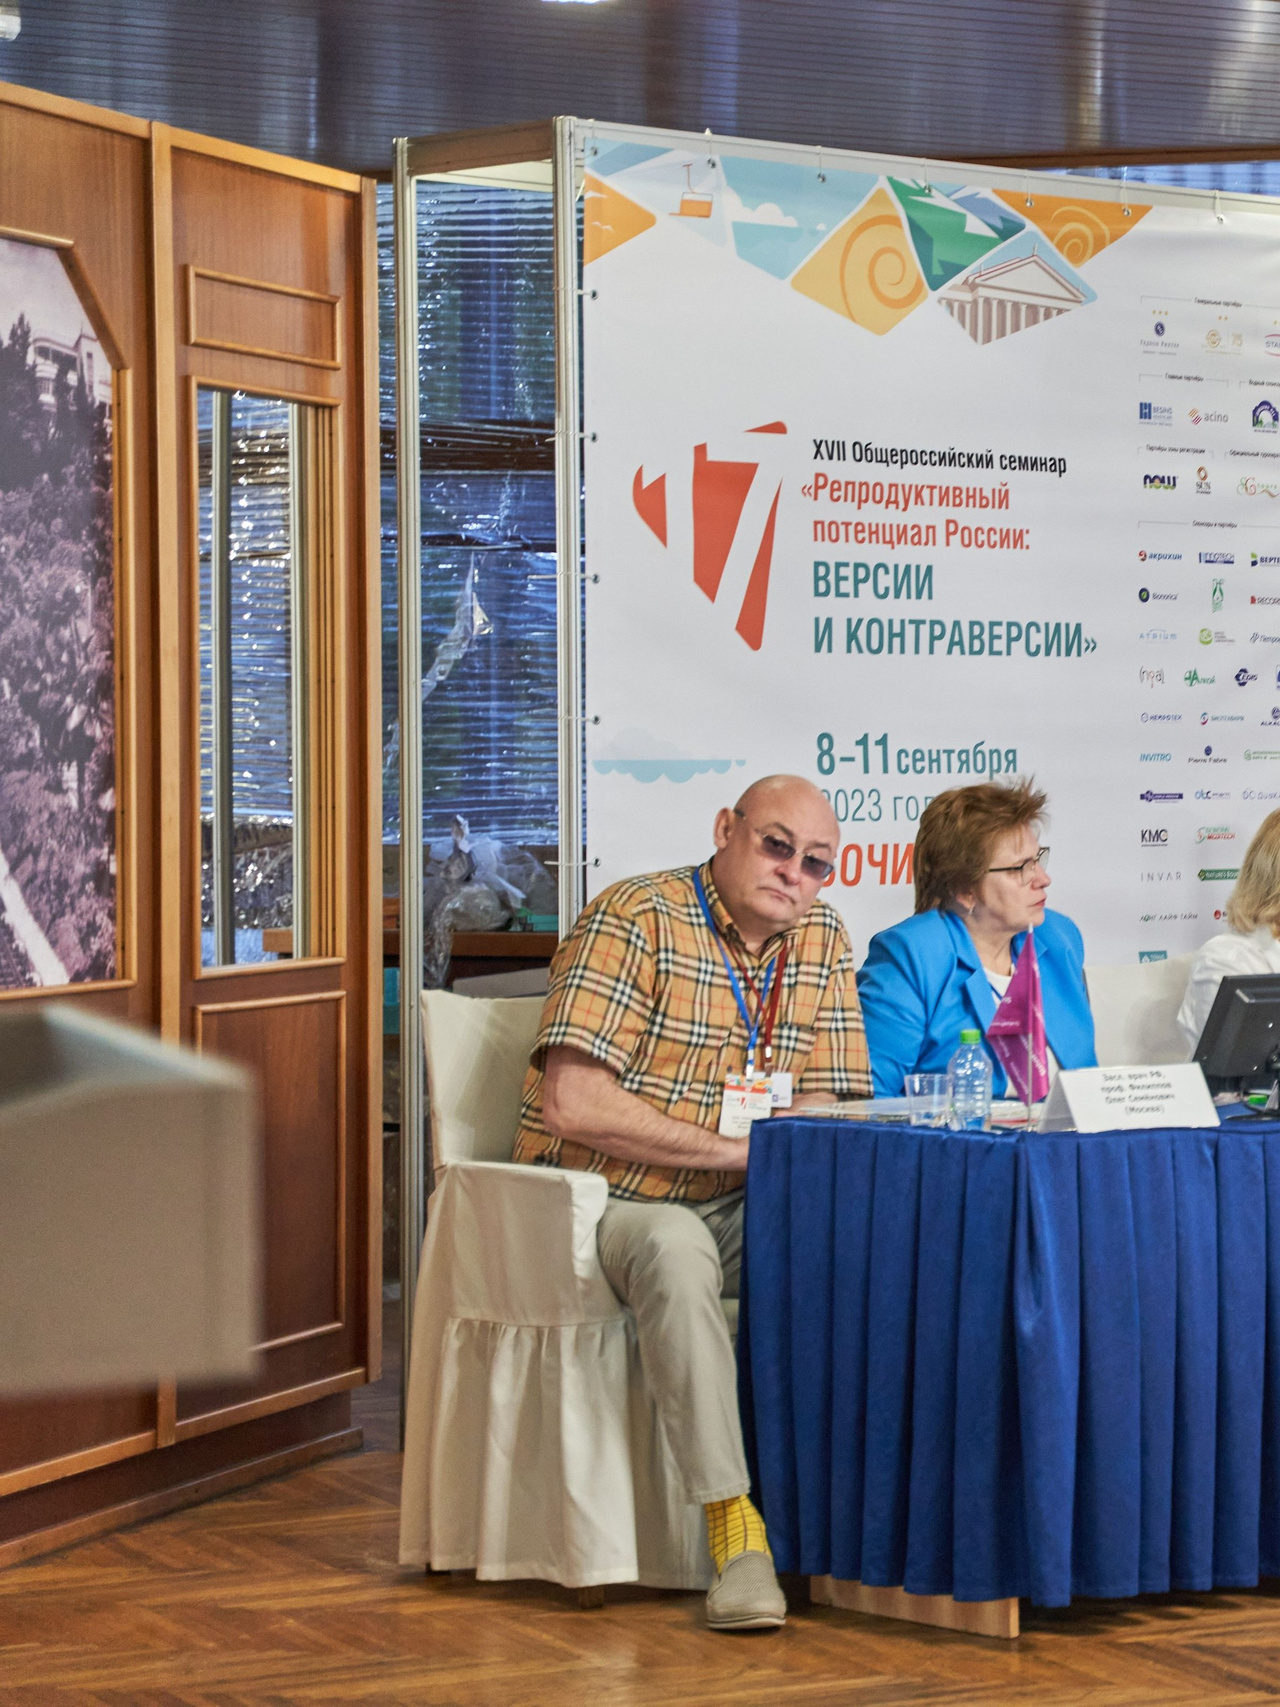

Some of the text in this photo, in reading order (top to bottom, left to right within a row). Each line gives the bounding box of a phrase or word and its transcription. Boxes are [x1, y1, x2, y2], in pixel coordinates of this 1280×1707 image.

[1204, 411, 1228, 422] acino
[812, 439, 1068, 478] XVII Общероссийский семинар
[801, 472, 1011, 511] «Репродуктивный
[812, 519, 1031, 551] потенциал России:
[1148, 552, 1183, 562] акрихин
[812, 561, 935, 602] ВЕРСИИ
[812, 616, 1098, 659] И КОНТРАВЕРСИИ»
[896, 740, 1019, 780] сентября
[1139, 753, 1172, 762] INVITRO
[822, 842, 915, 888] ОЧИ
